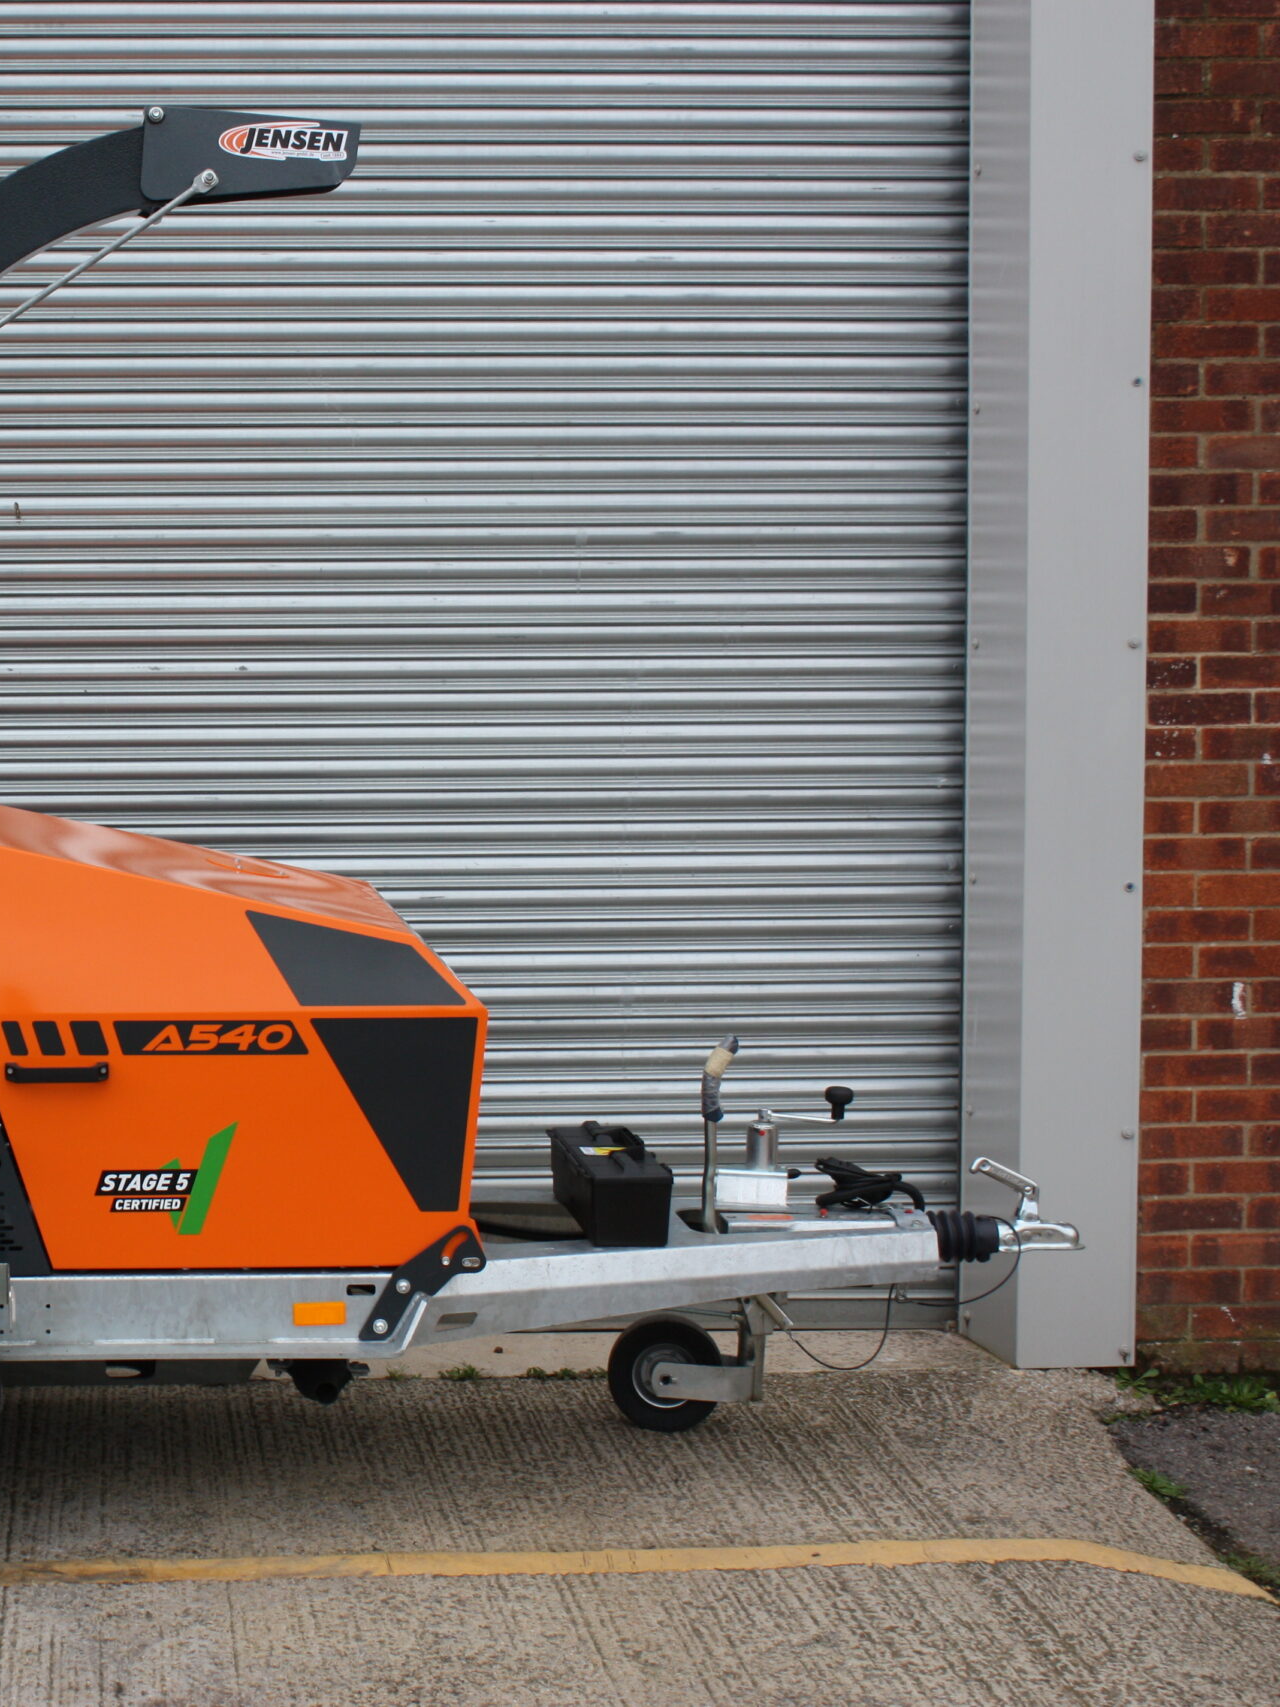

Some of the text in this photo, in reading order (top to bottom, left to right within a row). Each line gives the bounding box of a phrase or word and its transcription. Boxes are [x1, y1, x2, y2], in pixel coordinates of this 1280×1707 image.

[239, 127, 345, 153] JENSEN
[142, 1024, 293, 1051] A540
[100, 1173, 192, 1192] STAGE 5
[114, 1198, 181, 1211] CERTIFIED
